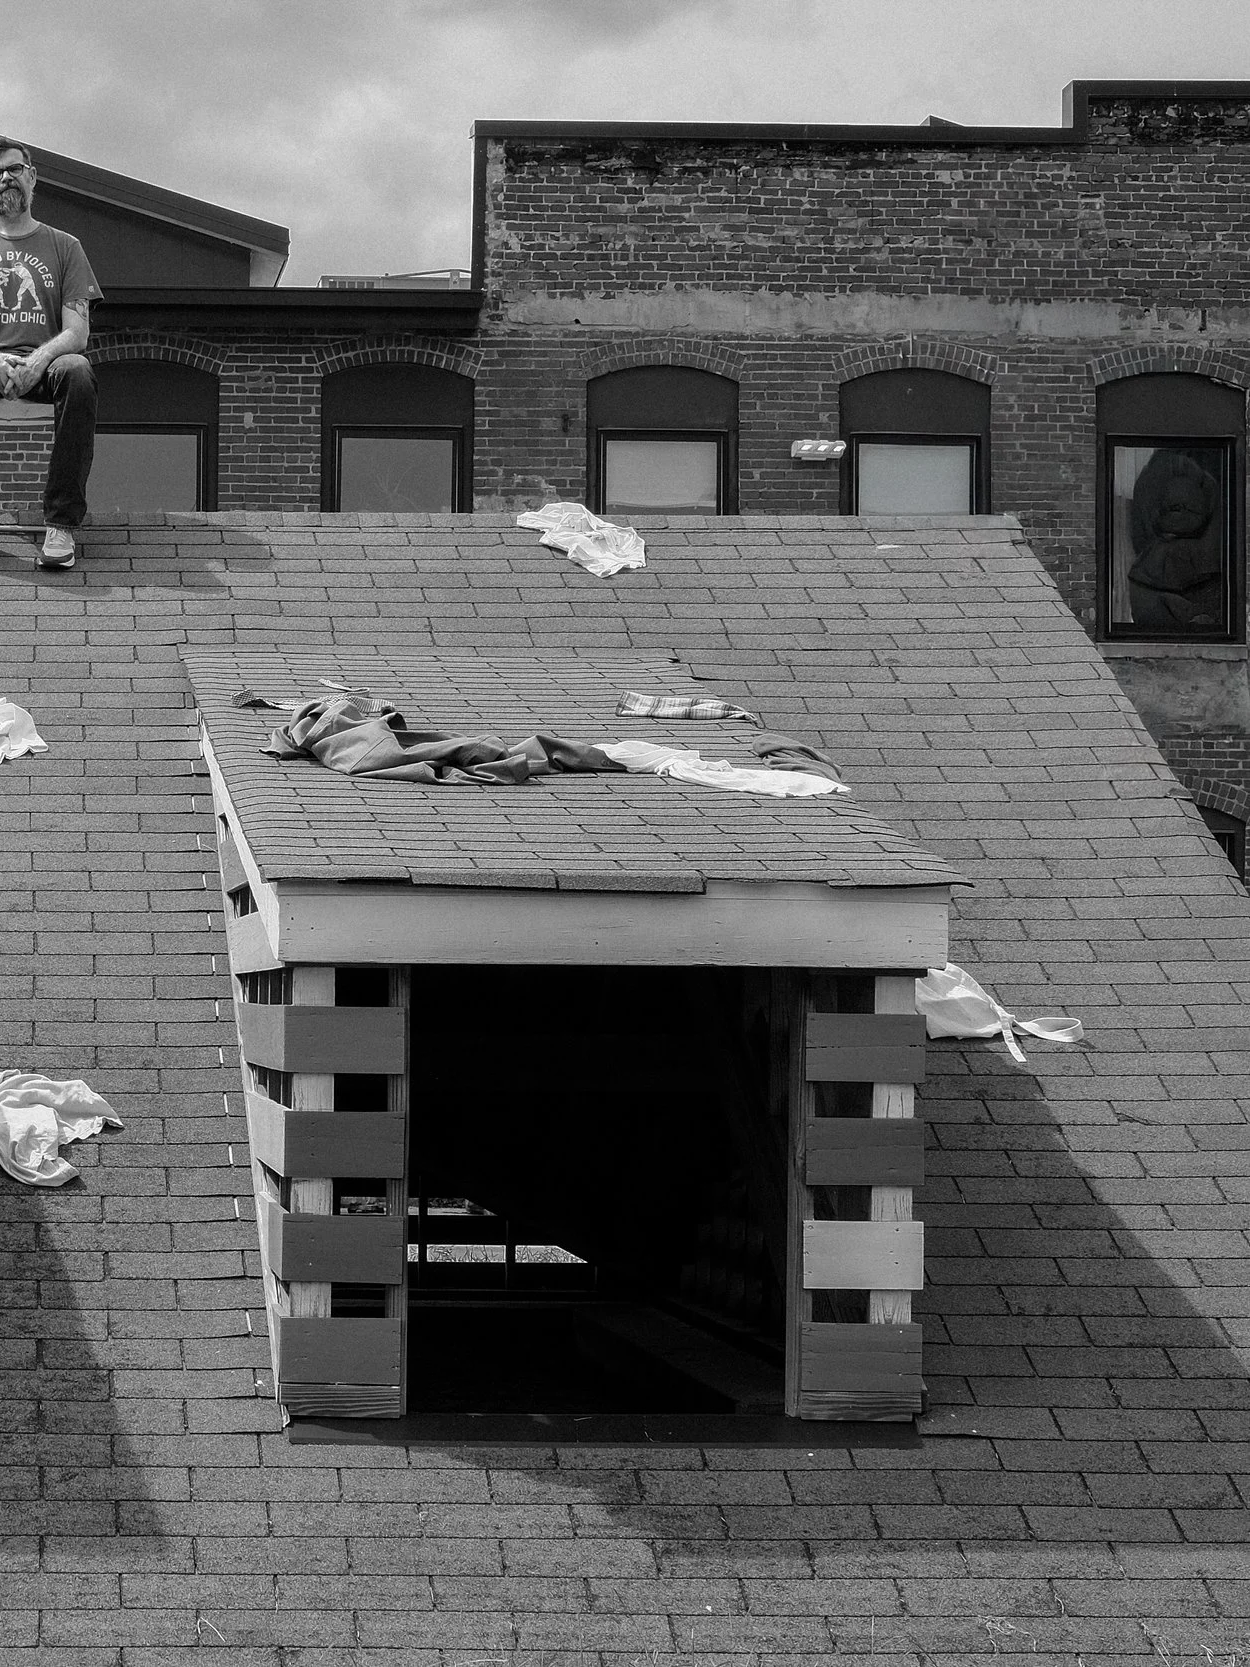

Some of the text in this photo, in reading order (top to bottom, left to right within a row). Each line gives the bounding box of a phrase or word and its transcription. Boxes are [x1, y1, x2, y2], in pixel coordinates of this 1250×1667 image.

[6, 250, 23, 261] BY
[24, 252, 55, 288] VOICES
[20, 311, 47, 325] OHIO
